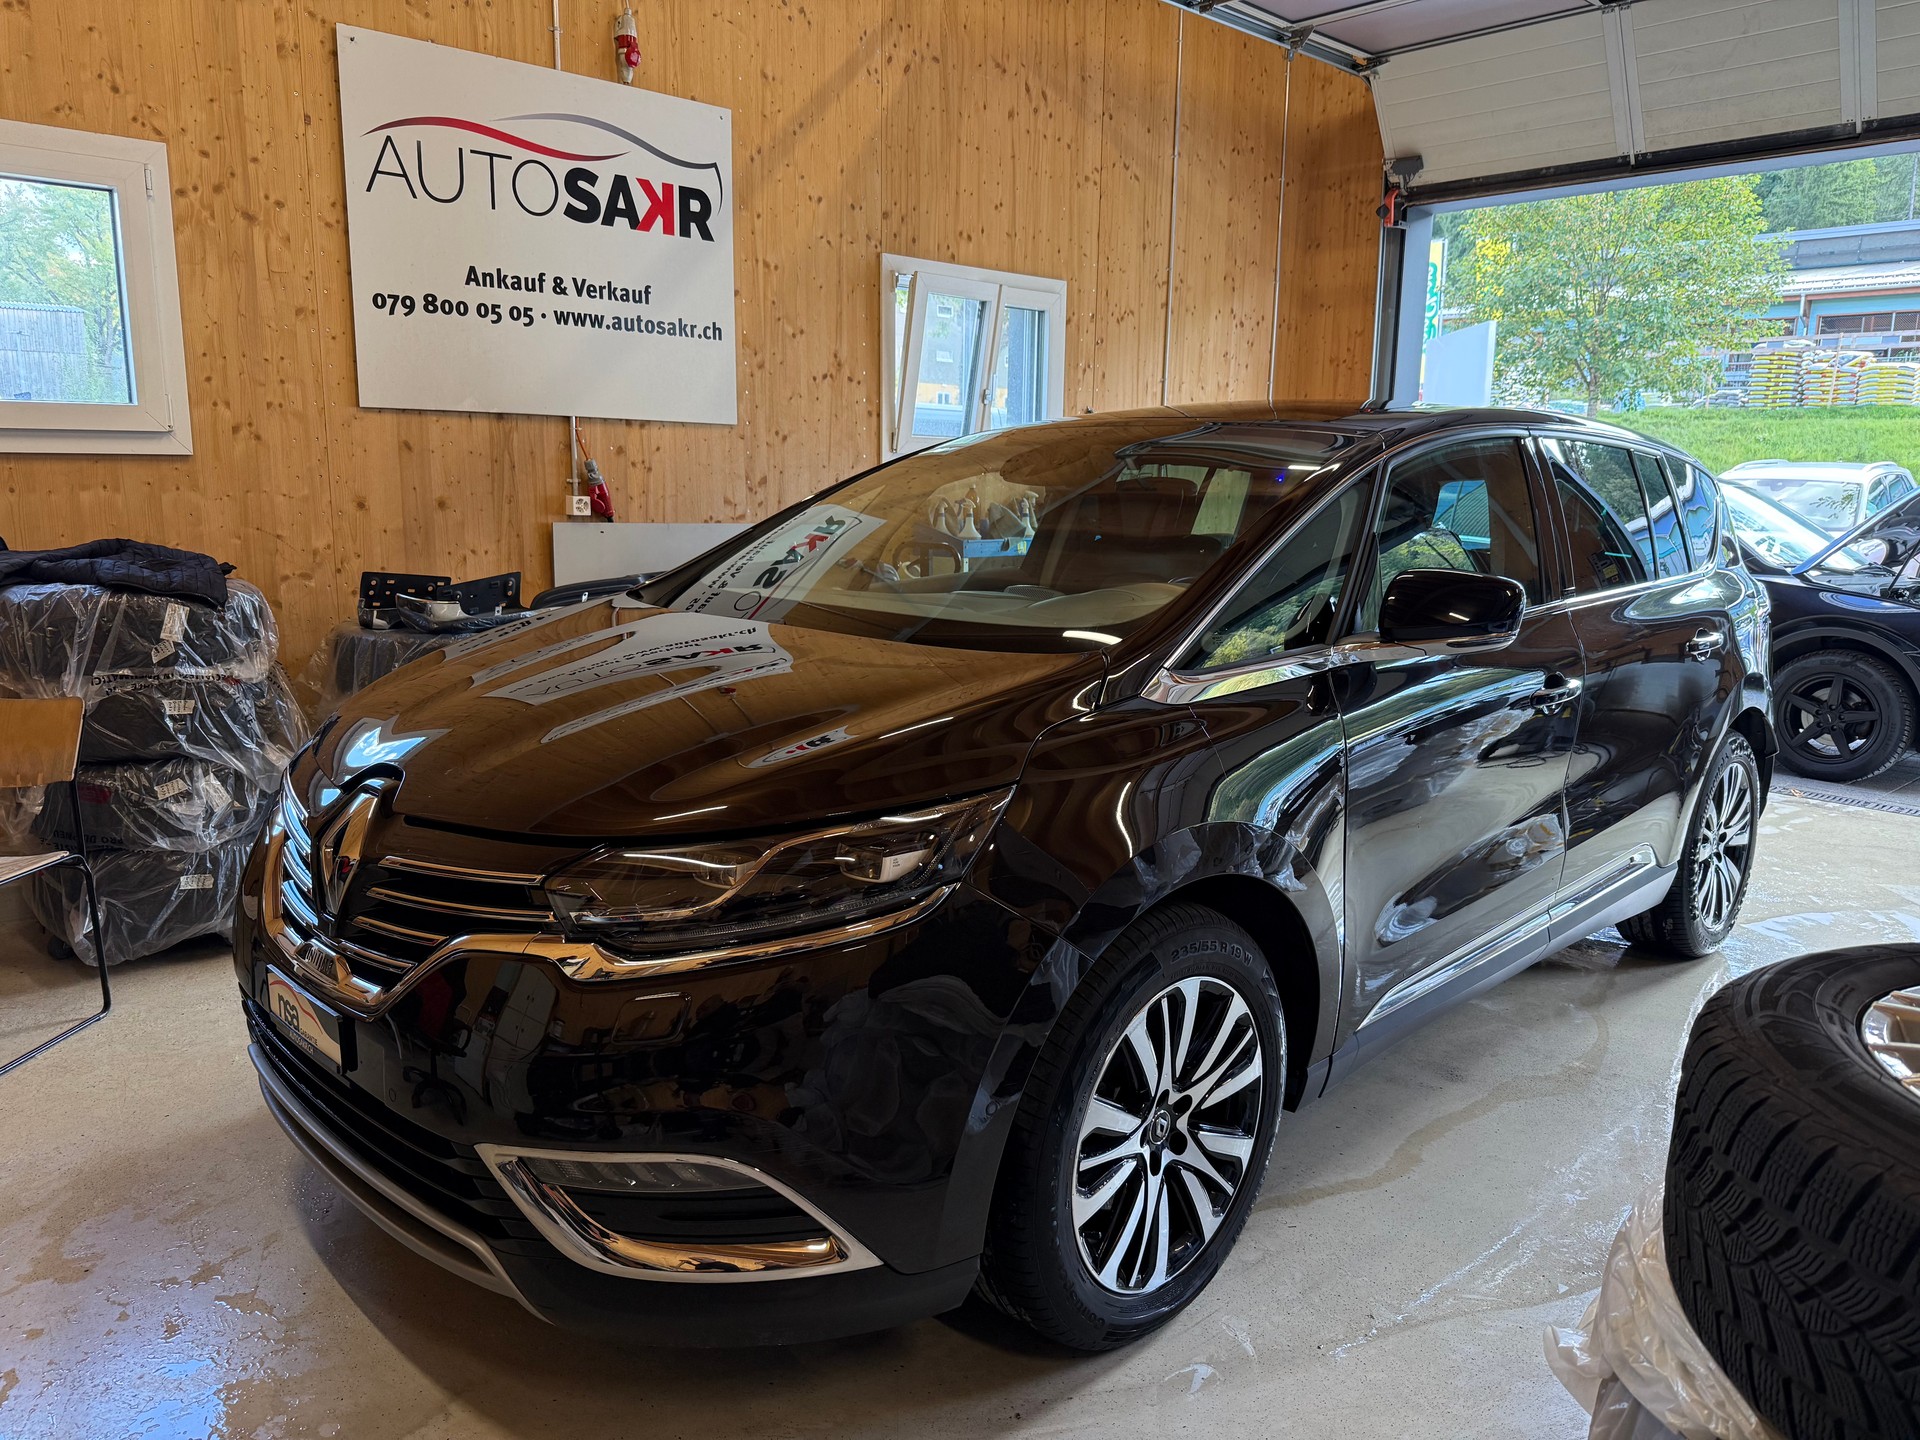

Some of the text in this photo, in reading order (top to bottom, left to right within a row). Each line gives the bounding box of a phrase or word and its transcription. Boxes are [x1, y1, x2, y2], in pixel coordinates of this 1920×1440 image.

[465, 265, 652, 305] Ankauf & Verkauf
[372, 292, 416, 316] 079
[423, 294, 469, 316] 800
[476, 304, 502, 325] 05
[508, 306, 535, 328] 05
[553, 310, 723, 341] www.autosakr.ch
[1170, 940, 1218, 964] 235/55
[1220, 941, 1229, 953] R
[1230, 944, 1243, 960] 19
[278, 993, 300, 1032] nsa
